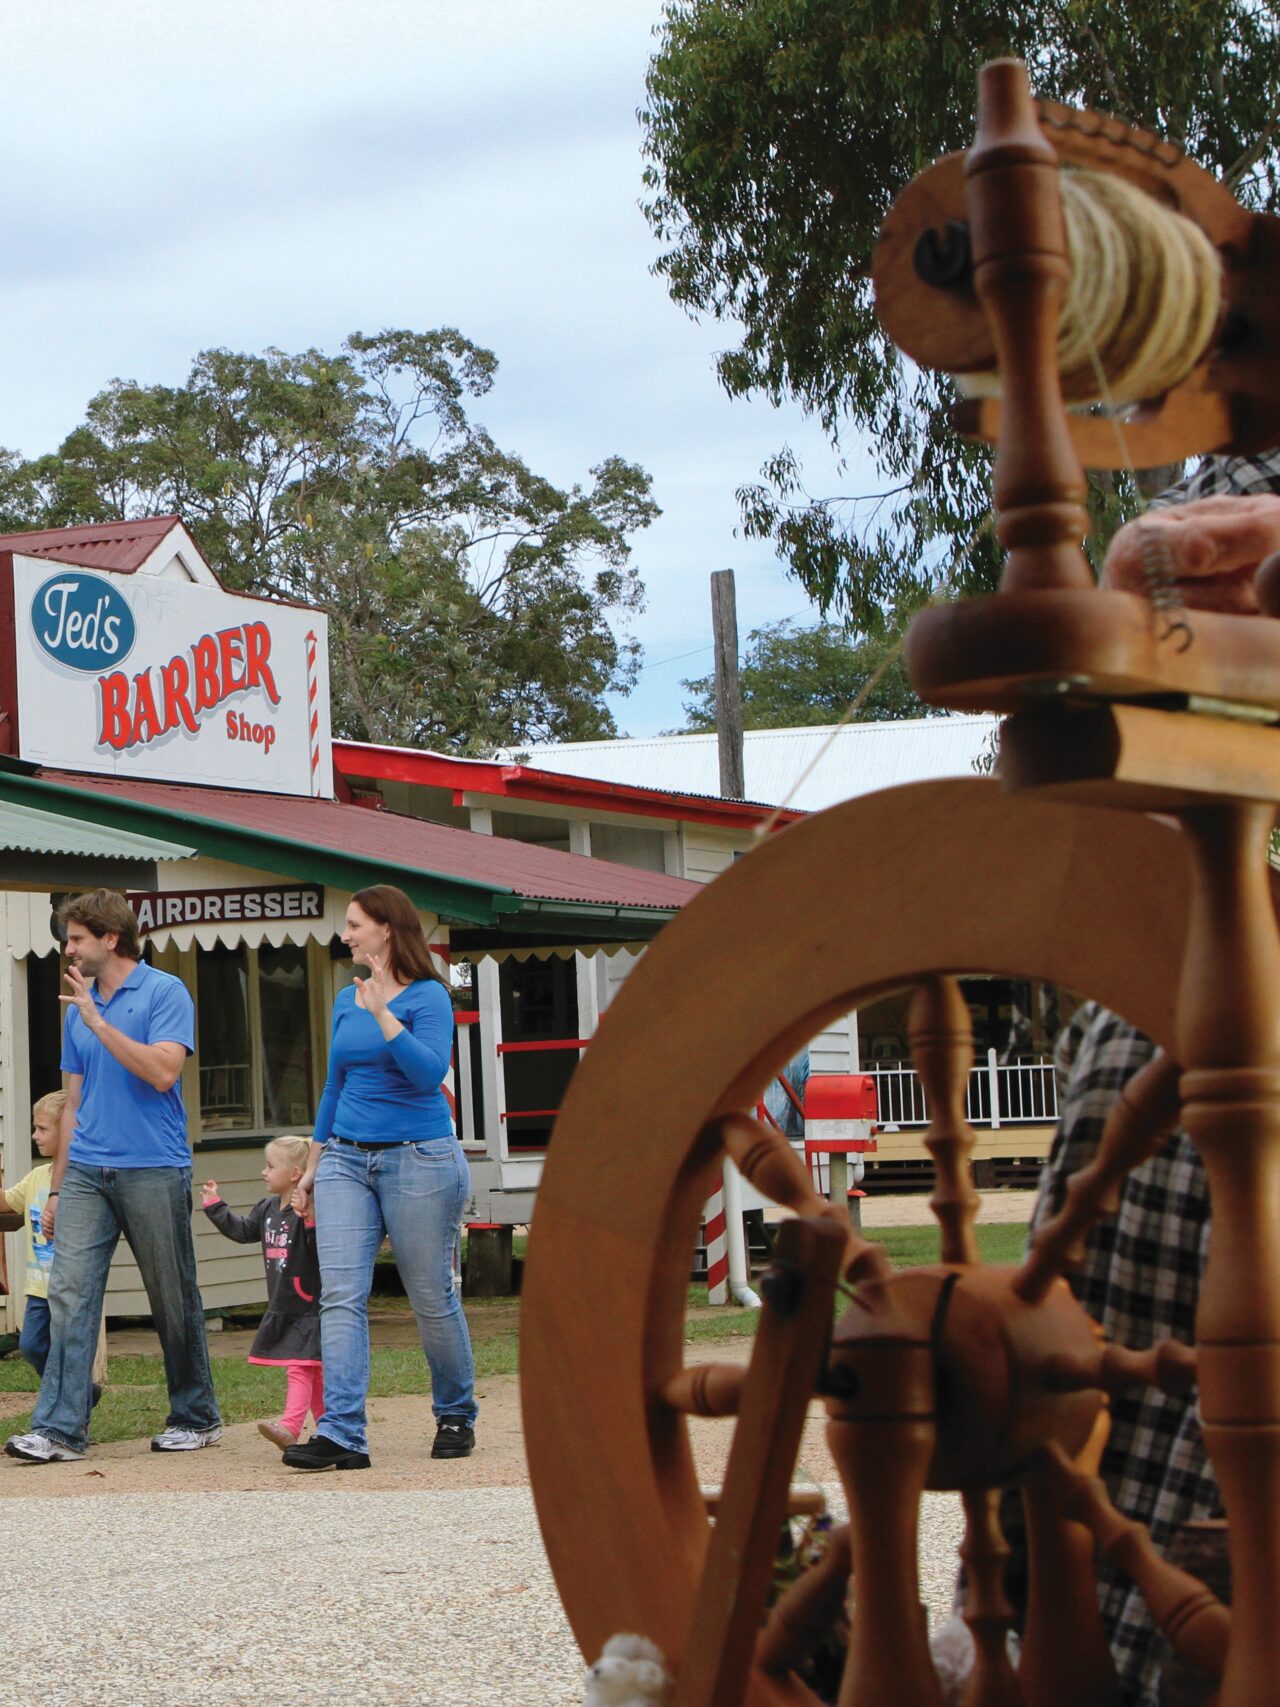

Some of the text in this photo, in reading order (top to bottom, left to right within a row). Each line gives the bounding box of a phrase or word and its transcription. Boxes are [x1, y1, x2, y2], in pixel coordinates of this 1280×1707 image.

[43, 582, 121, 654] Ted's
[99, 621, 281, 750] BARBER
[226, 710, 276, 754] Shop
[127, 891, 319, 931] AIRDRESSER
